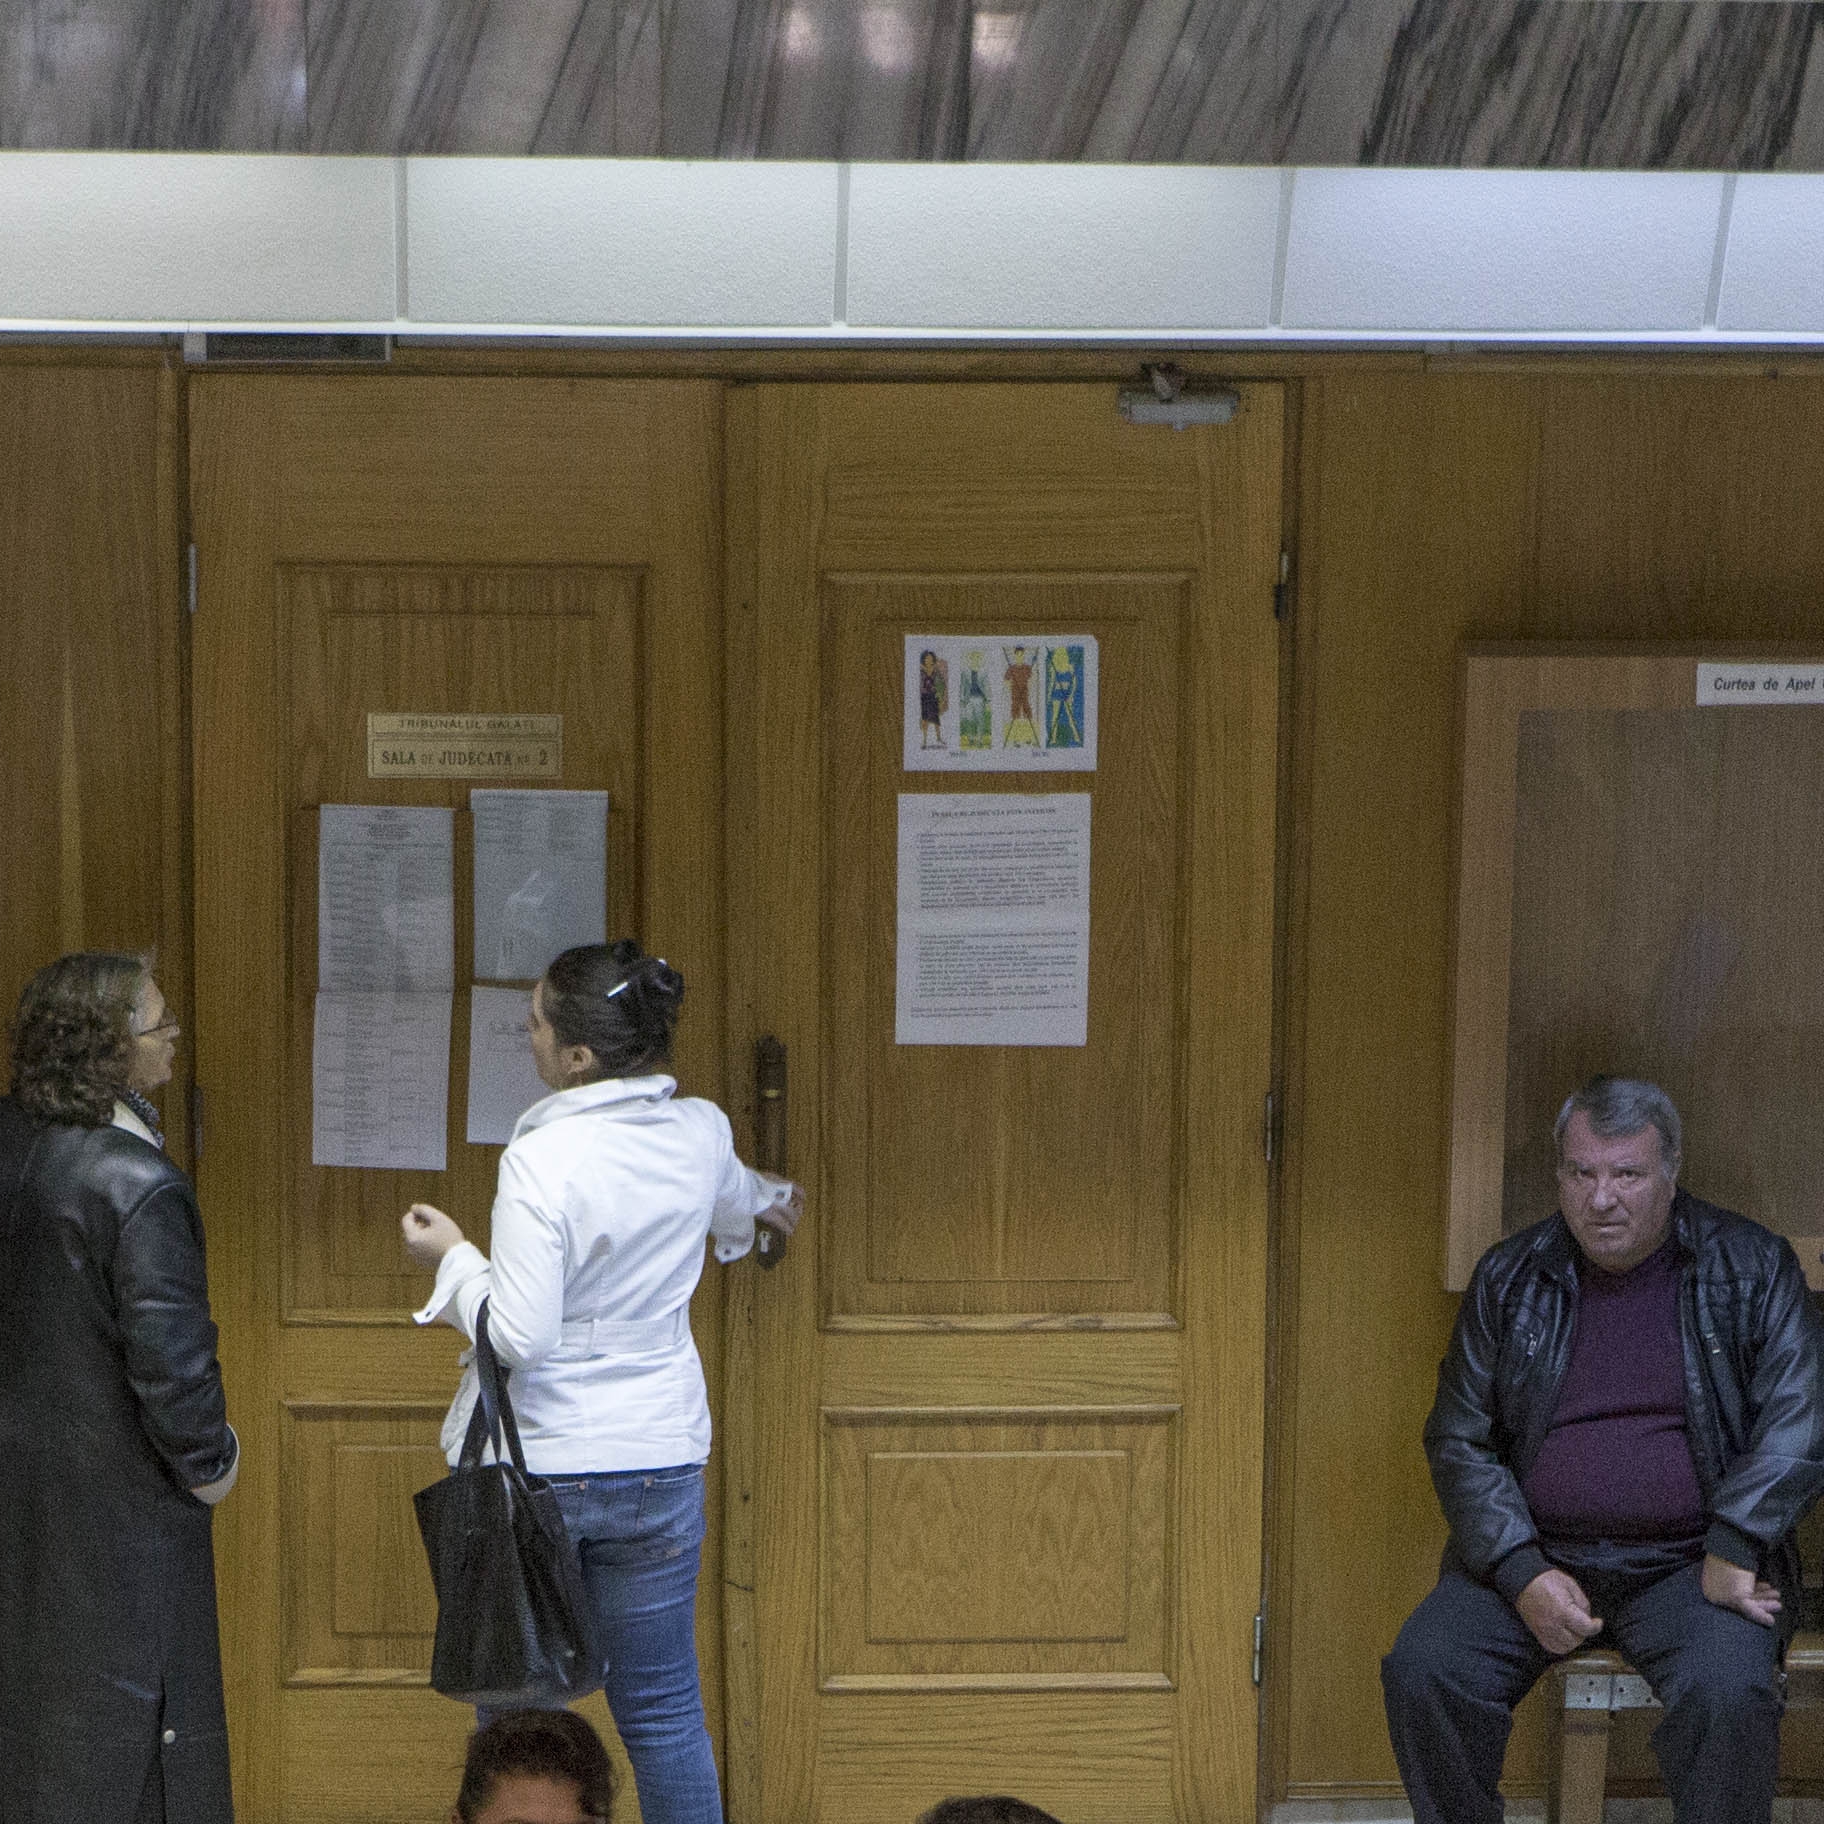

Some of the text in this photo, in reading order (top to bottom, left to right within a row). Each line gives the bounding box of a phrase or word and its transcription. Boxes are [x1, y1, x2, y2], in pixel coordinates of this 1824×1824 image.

[1713, 677, 1756, 691] Curtea
[1763, 677, 1779, 691] de
[1785, 677, 1816, 693] Apel
[399, 719, 482, 730] TRIBUNALUL
[381, 751, 416, 766] SALA
[438, 751, 512, 766] JUDECATA
[538, 749, 548, 766] 2
